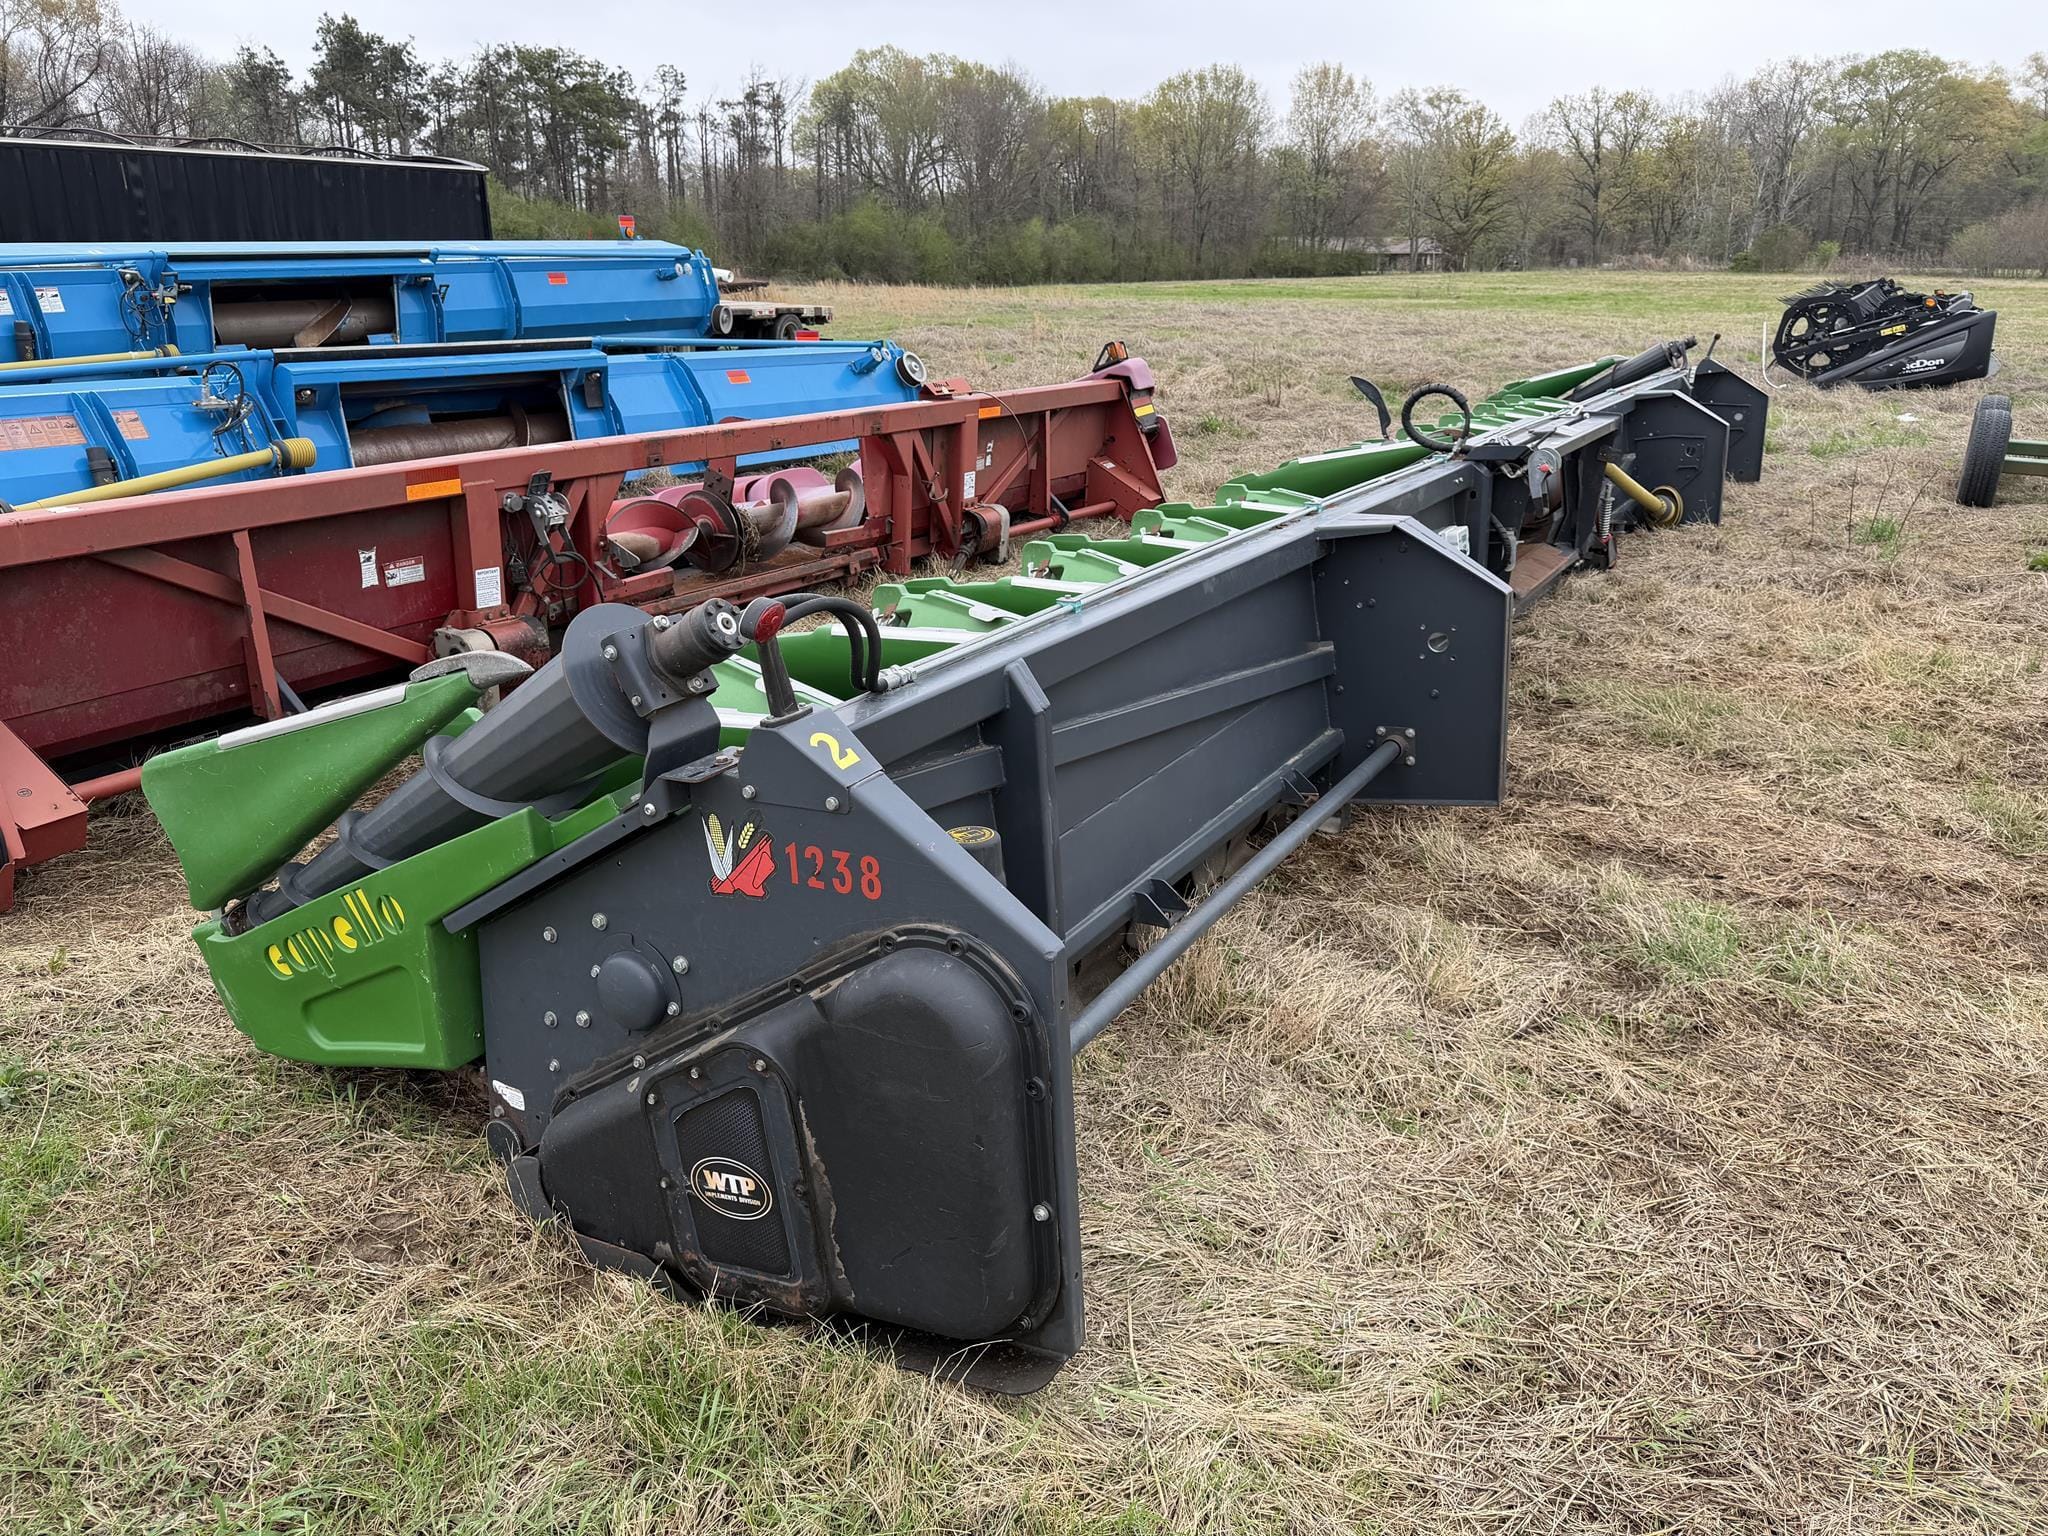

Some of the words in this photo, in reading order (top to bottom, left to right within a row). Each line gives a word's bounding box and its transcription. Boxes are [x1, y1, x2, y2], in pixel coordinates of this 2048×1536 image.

[810, 732, 861, 770] 2
[785, 842, 882, 900] 1238
[703, 1169, 756, 1196] WTP
[704, 1190, 738, 1202] IMPLEMENTS
[738, 1196, 761, 1206] DIVISION
